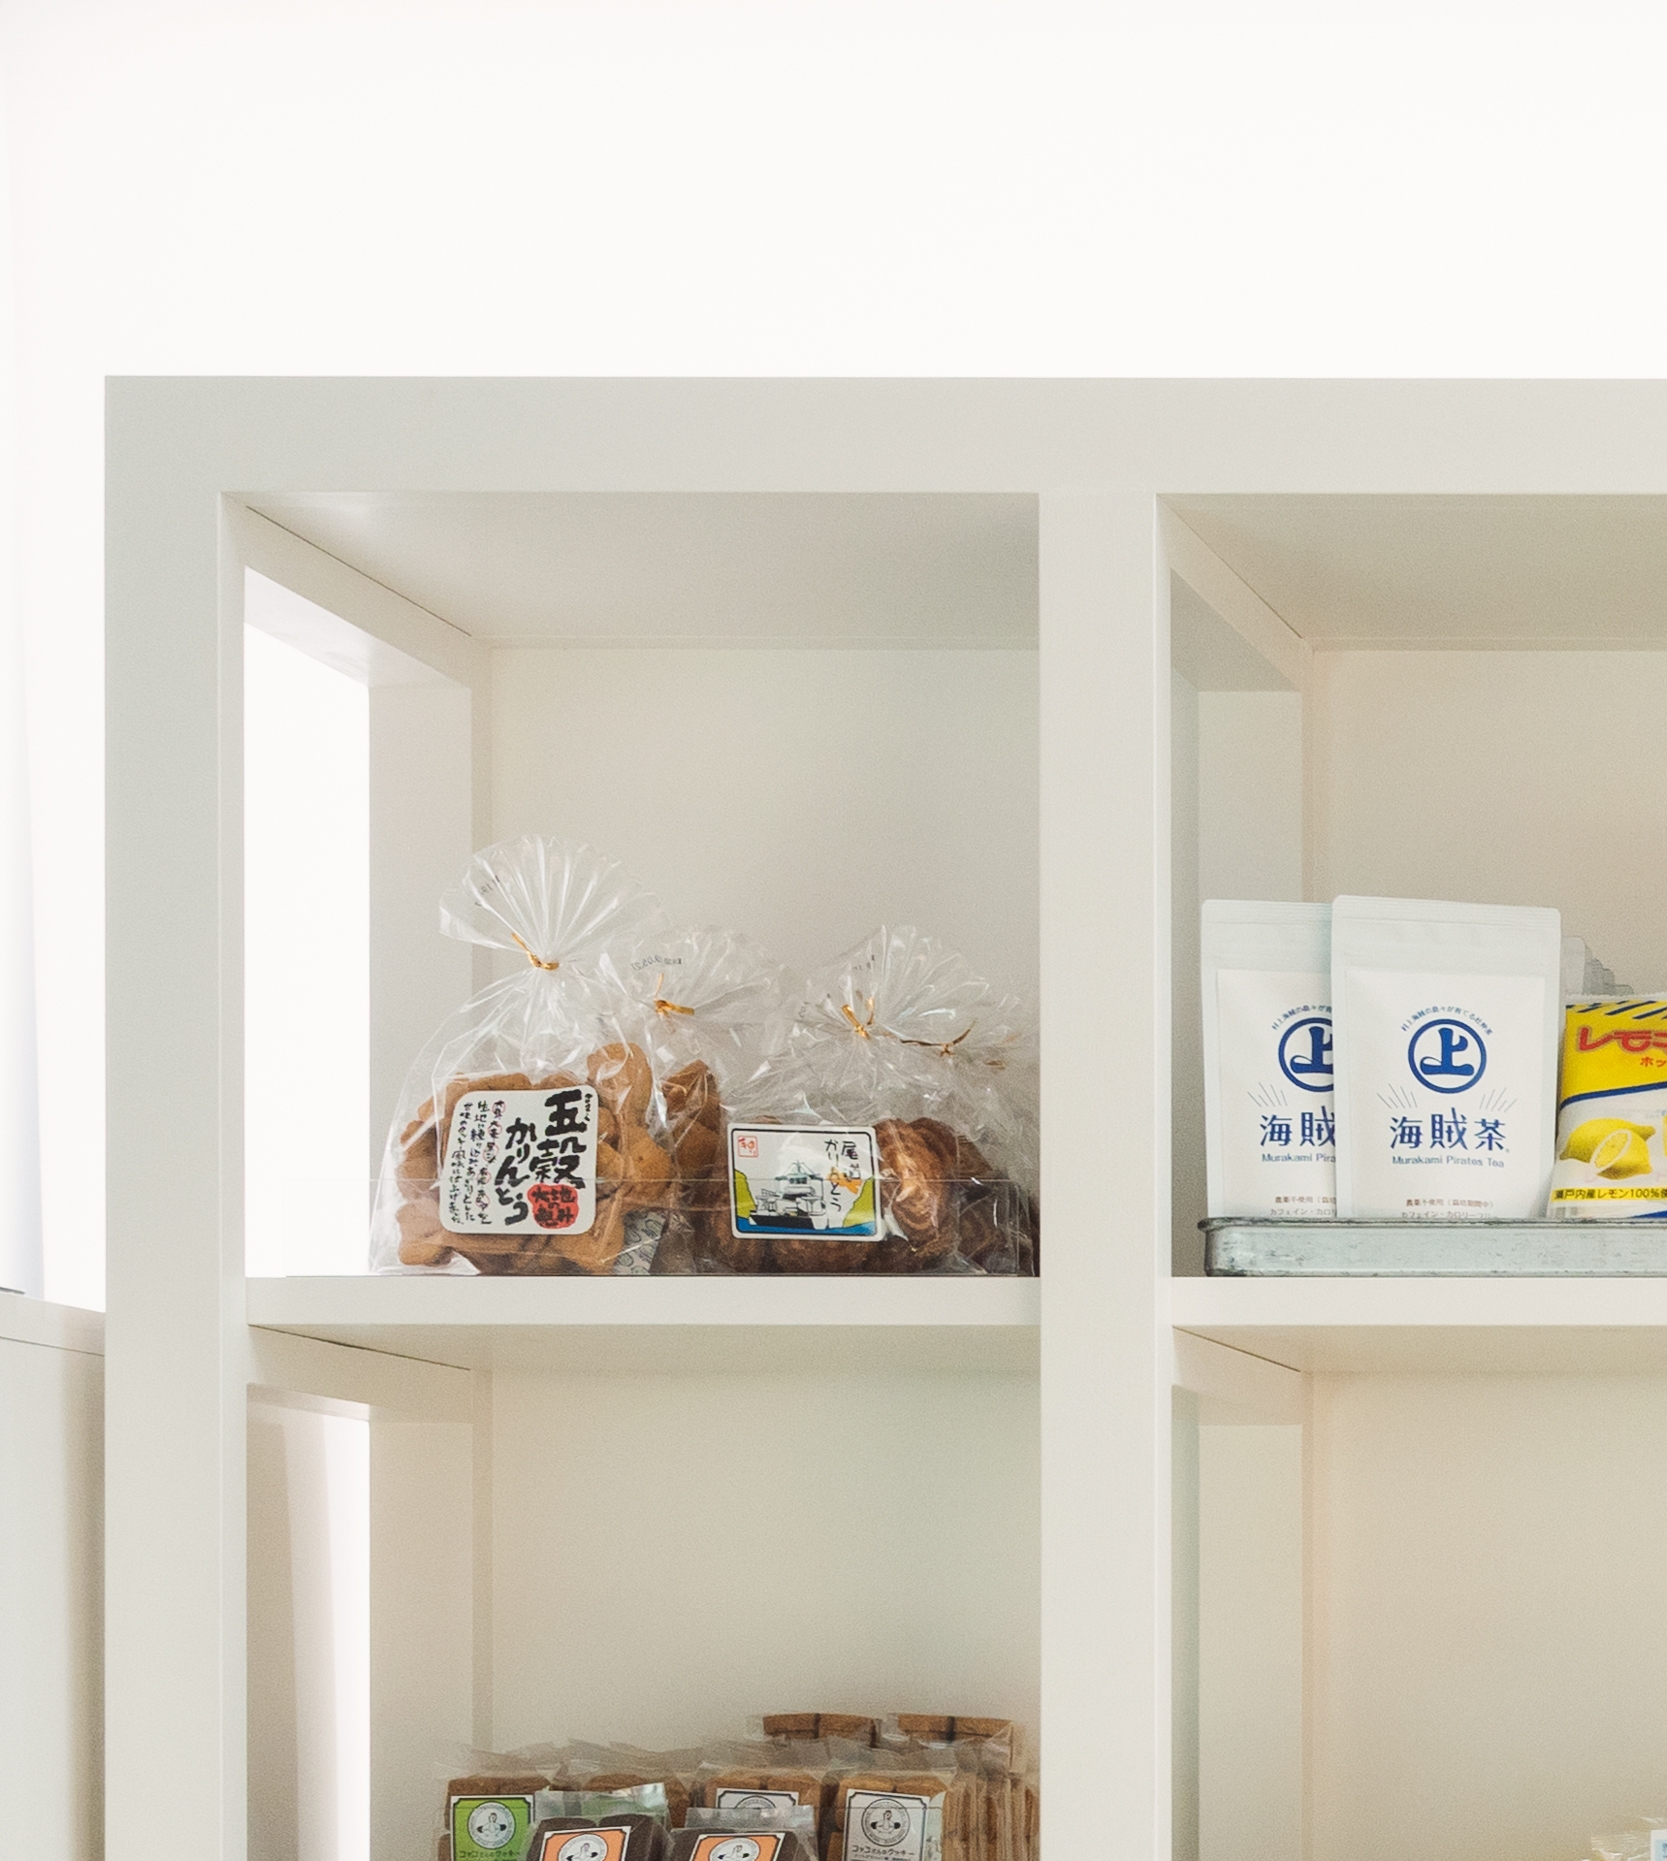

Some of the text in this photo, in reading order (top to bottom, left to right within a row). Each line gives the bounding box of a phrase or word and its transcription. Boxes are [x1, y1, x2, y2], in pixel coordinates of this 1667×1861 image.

[1420, 1027, 1475, 1076] 上
[529, 1089, 588, 1189] 五穀
[1389, 1107, 1506, 1151] 海賊茶
[494, 1117, 537, 1226] かりんとう
[1262, 1153, 1312, 1162] Murakami
[1392, 1155, 1505, 1168] Murakami Pirates Tea
